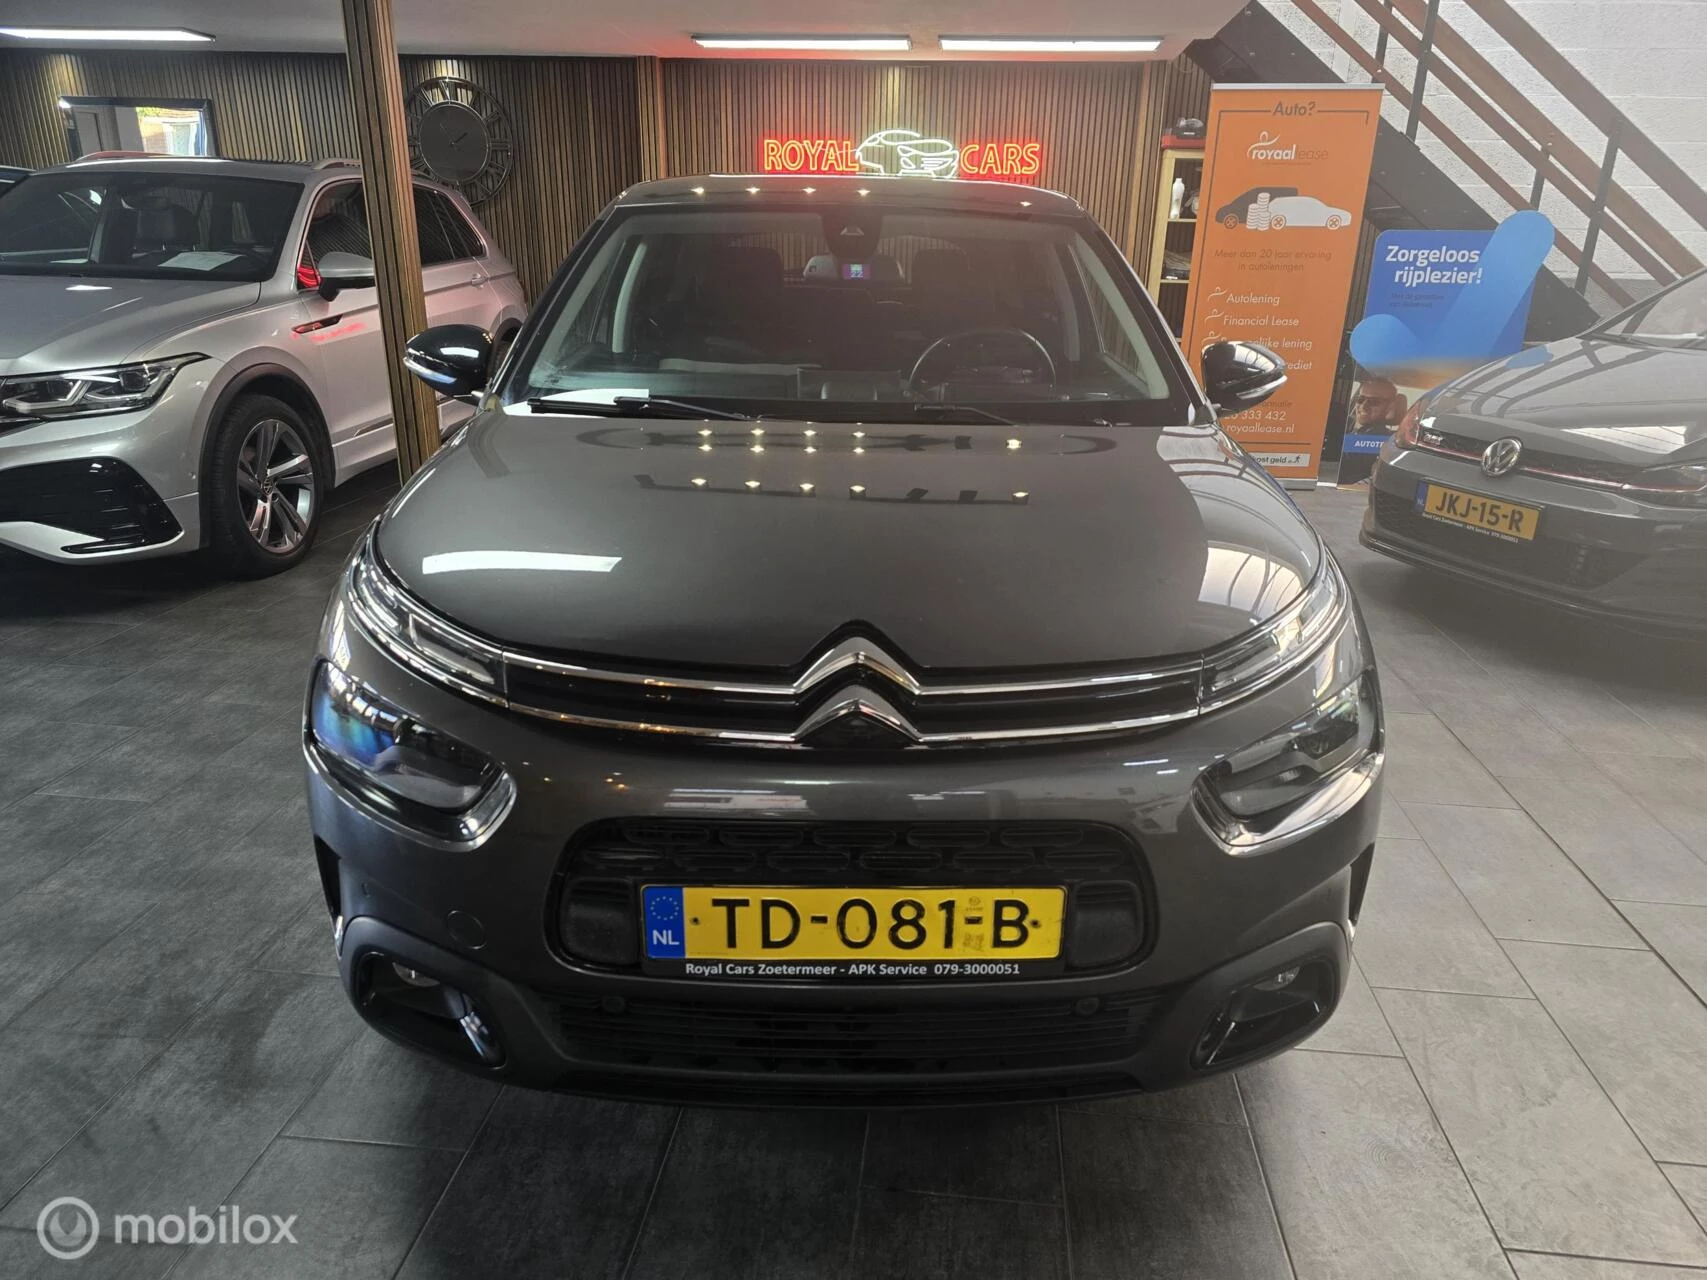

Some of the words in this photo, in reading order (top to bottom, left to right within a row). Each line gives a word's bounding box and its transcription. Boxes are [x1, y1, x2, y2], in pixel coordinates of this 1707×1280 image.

[1272, 101, 1316, 116] Auto?
[763, 139, 860, 172] ROYAL
[960, 143, 1040, 174] CARS
[1385, 245, 1481, 267] Zorgeloos
[1394, 267, 1483, 287] rijplezier!
[1226, 293, 1280, 305] Autolening
[1223, 315, 1269, 326] Financial
[1271, 315, 1299, 326] Lease
[1282, 338, 1312, 351] lening
[1265, 410, 1287, 421] 432
[1223, 422, 1295, 434] royaallease.nl
[1270, 456, 1287, 464] geld
[1435, 491, 1524, 532] JKJ-15-R
[652, 930, 680, 946] NL
[711, 897, 1030, 950] TD-081-B
[686, 963, 723, 977] Royal
[725, 963, 756, 975] Cars
[757, 963, 837, 975] Zoetermeer
[848, 963, 877, 975] APK
[879, 963, 927, 975] Service
[934, 963, 1020, 975] 079-3000051
